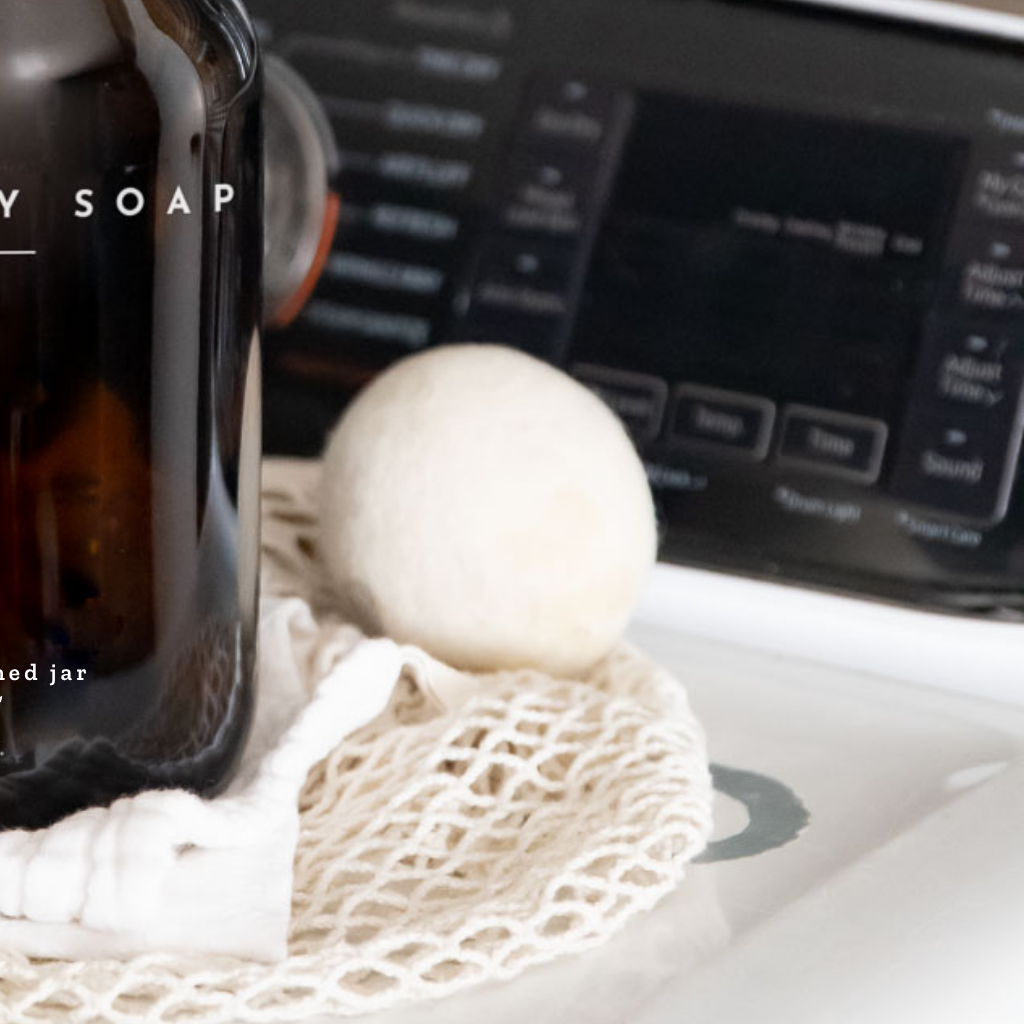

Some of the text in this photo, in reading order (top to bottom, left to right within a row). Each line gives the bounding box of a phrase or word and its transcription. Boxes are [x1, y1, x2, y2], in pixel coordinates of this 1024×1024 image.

[74, 184, 235, 217] SOAP
[943, 355, 1002, 380] Adjust
[923, 451, 984, 482] Sound
[49, 663, 88, 686] jar
